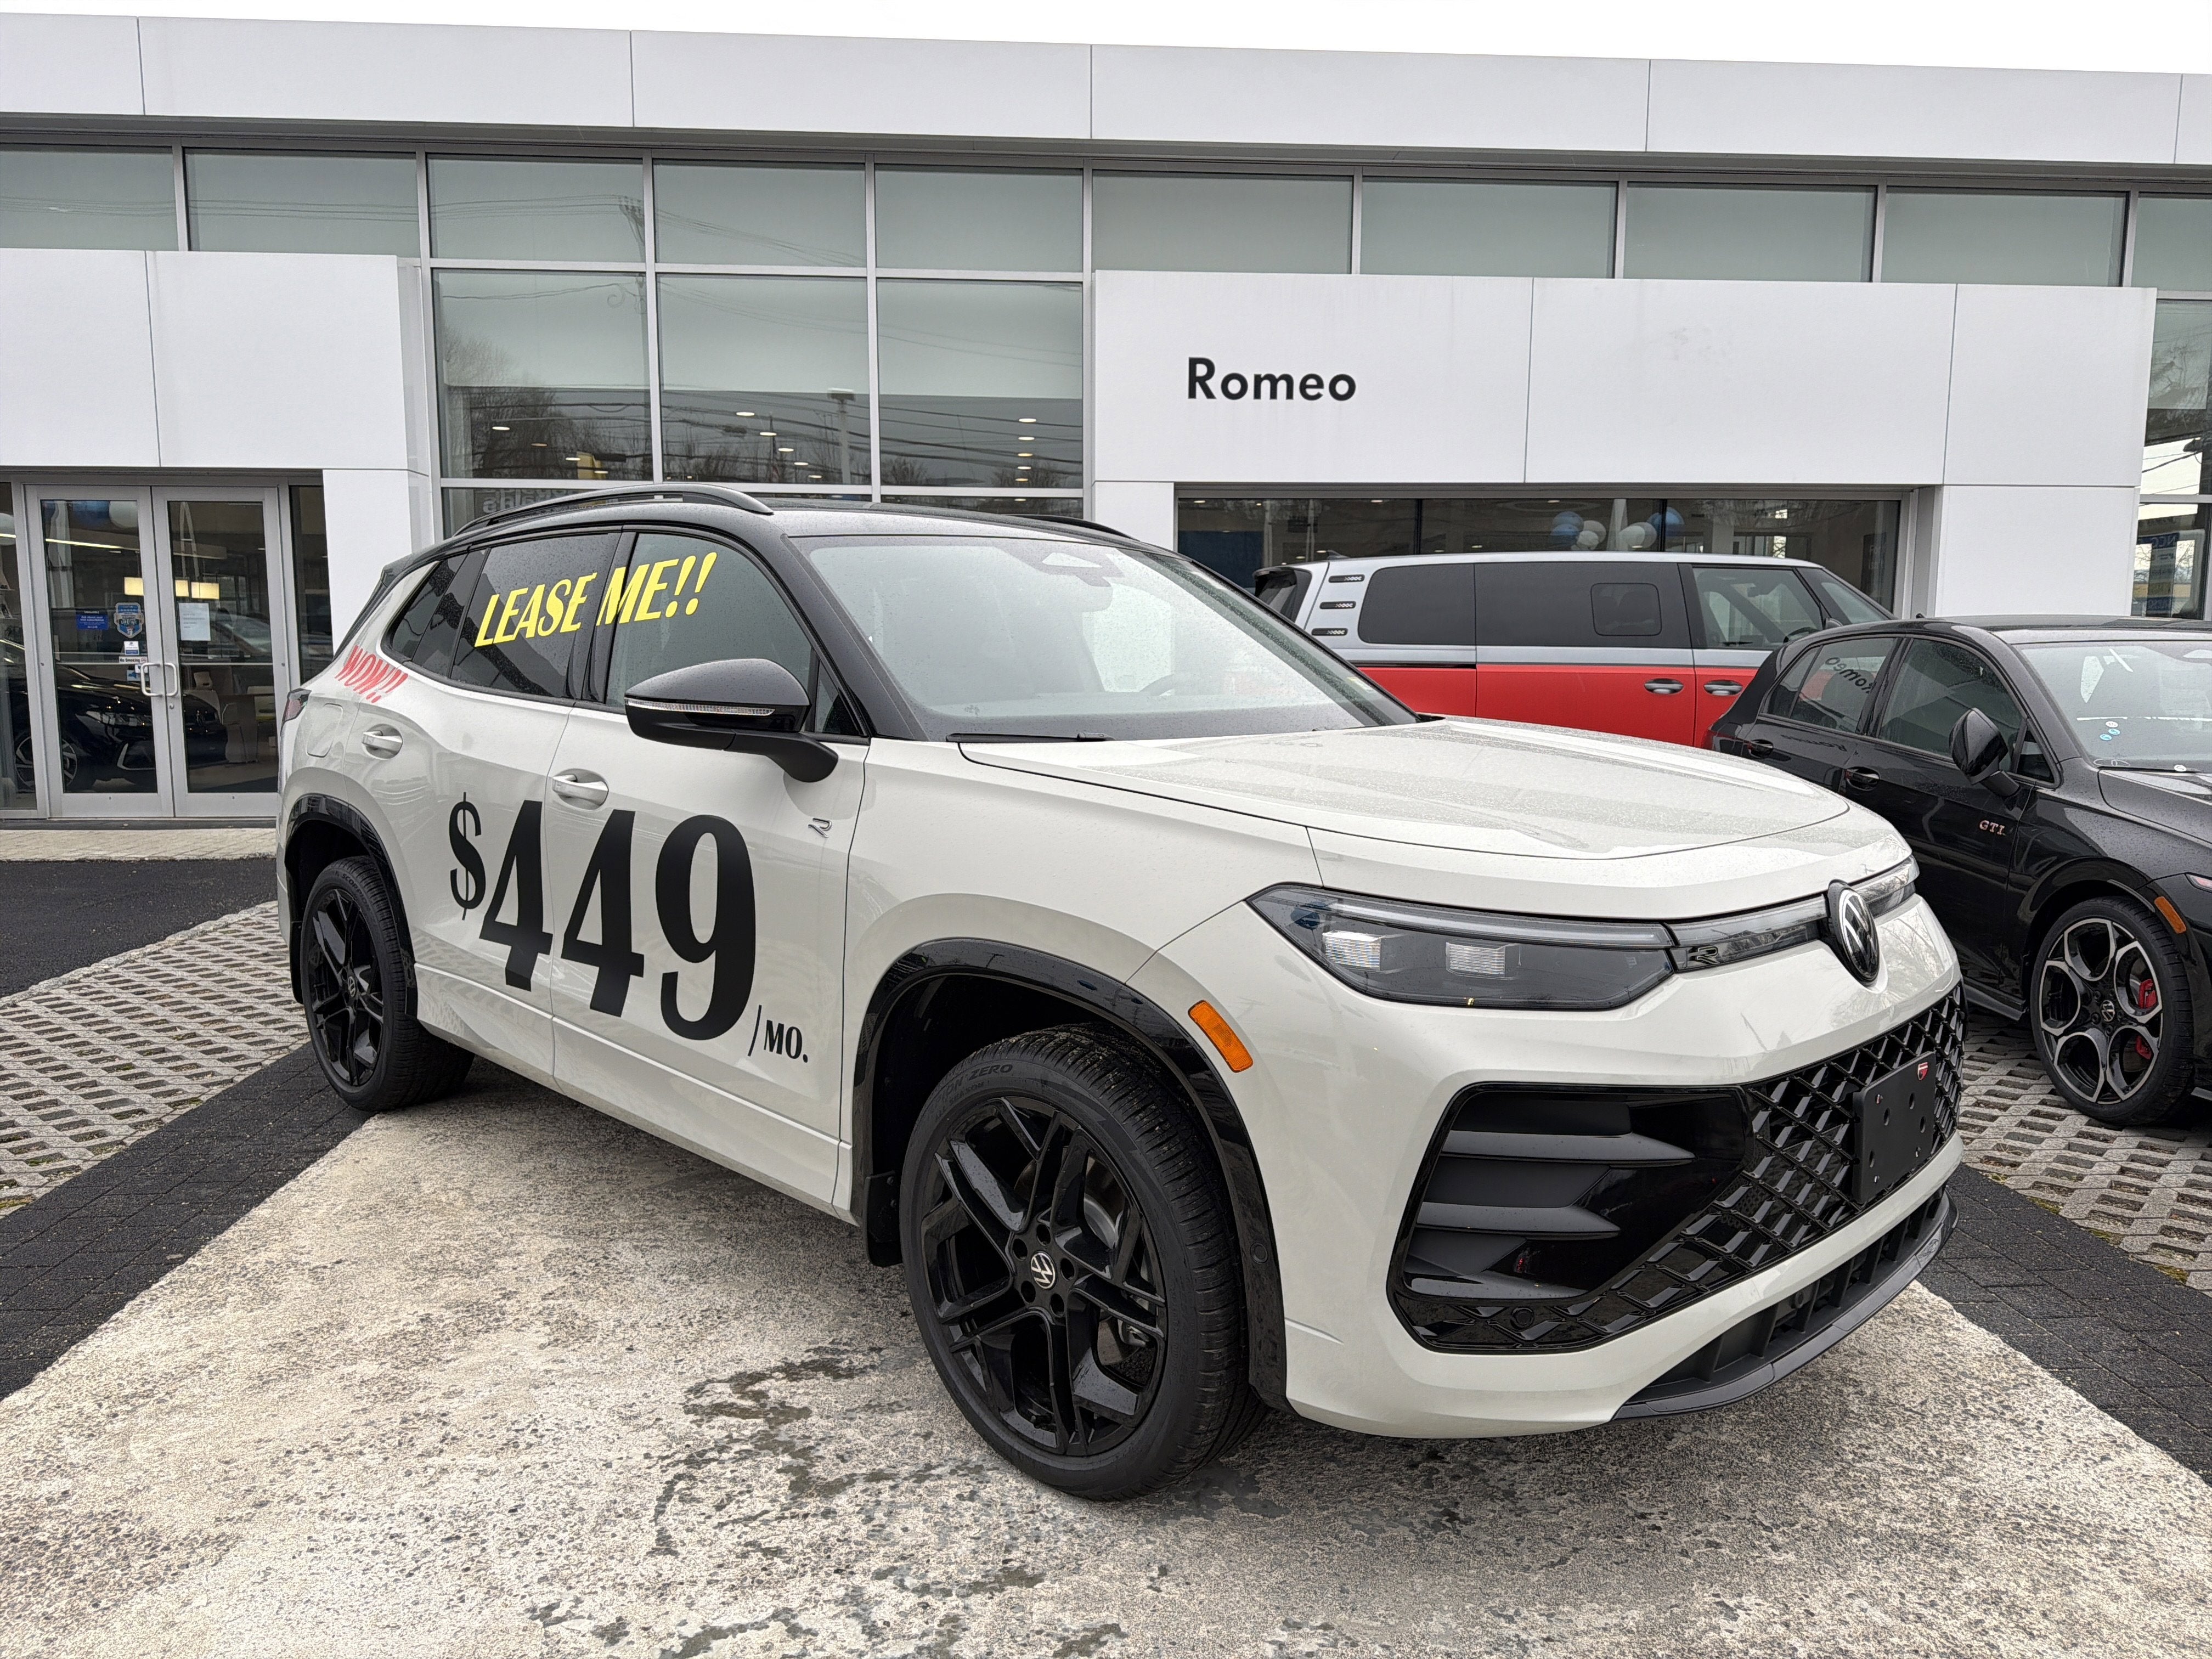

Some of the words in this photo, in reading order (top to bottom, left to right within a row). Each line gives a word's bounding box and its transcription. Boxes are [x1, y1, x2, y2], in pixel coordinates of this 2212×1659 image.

[1187, 357, 1356, 401] Romeo
[474, 572, 597, 648] LEASE
[596, 552, 717, 626] ME!!
[334, 645, 408, 703] WOW!!
[1979, 820, 2005, 835] GTI
[449, 792, 756, 1041] $449
[968, 1064, 1013, 1081] ZERO
